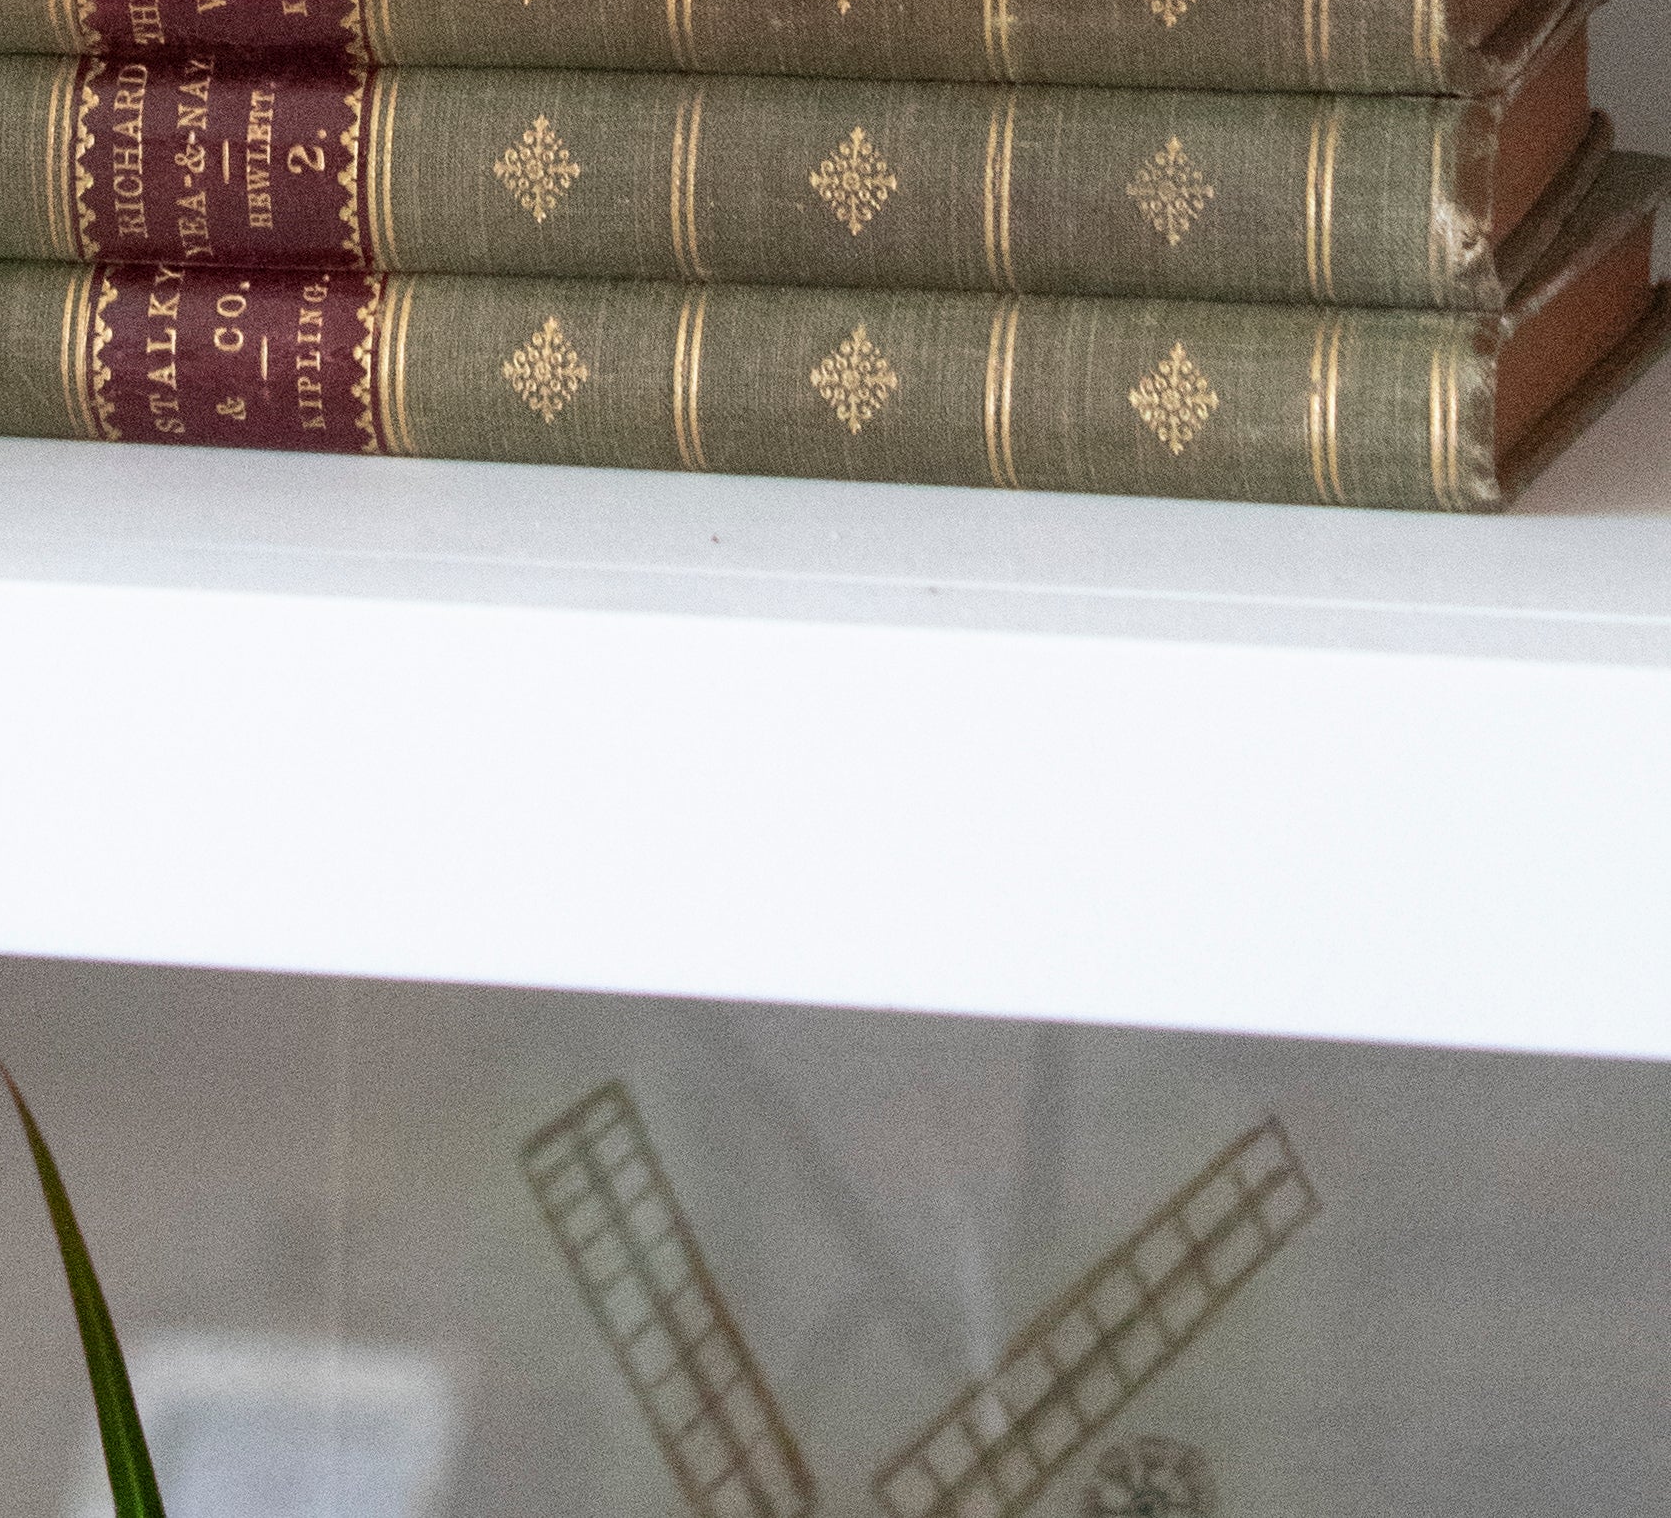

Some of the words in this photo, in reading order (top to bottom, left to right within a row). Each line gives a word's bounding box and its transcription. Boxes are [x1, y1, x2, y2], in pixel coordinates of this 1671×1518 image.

[113, 64, 150, 238] RICHARD
[287, 127, 328, 175] 2.
[146, 259, 185, 434] STALKY
[213, 280, 252, 353] CO.
[296, 272, 331, 431] KIPLING.
[215, 395, 247, 420] &
